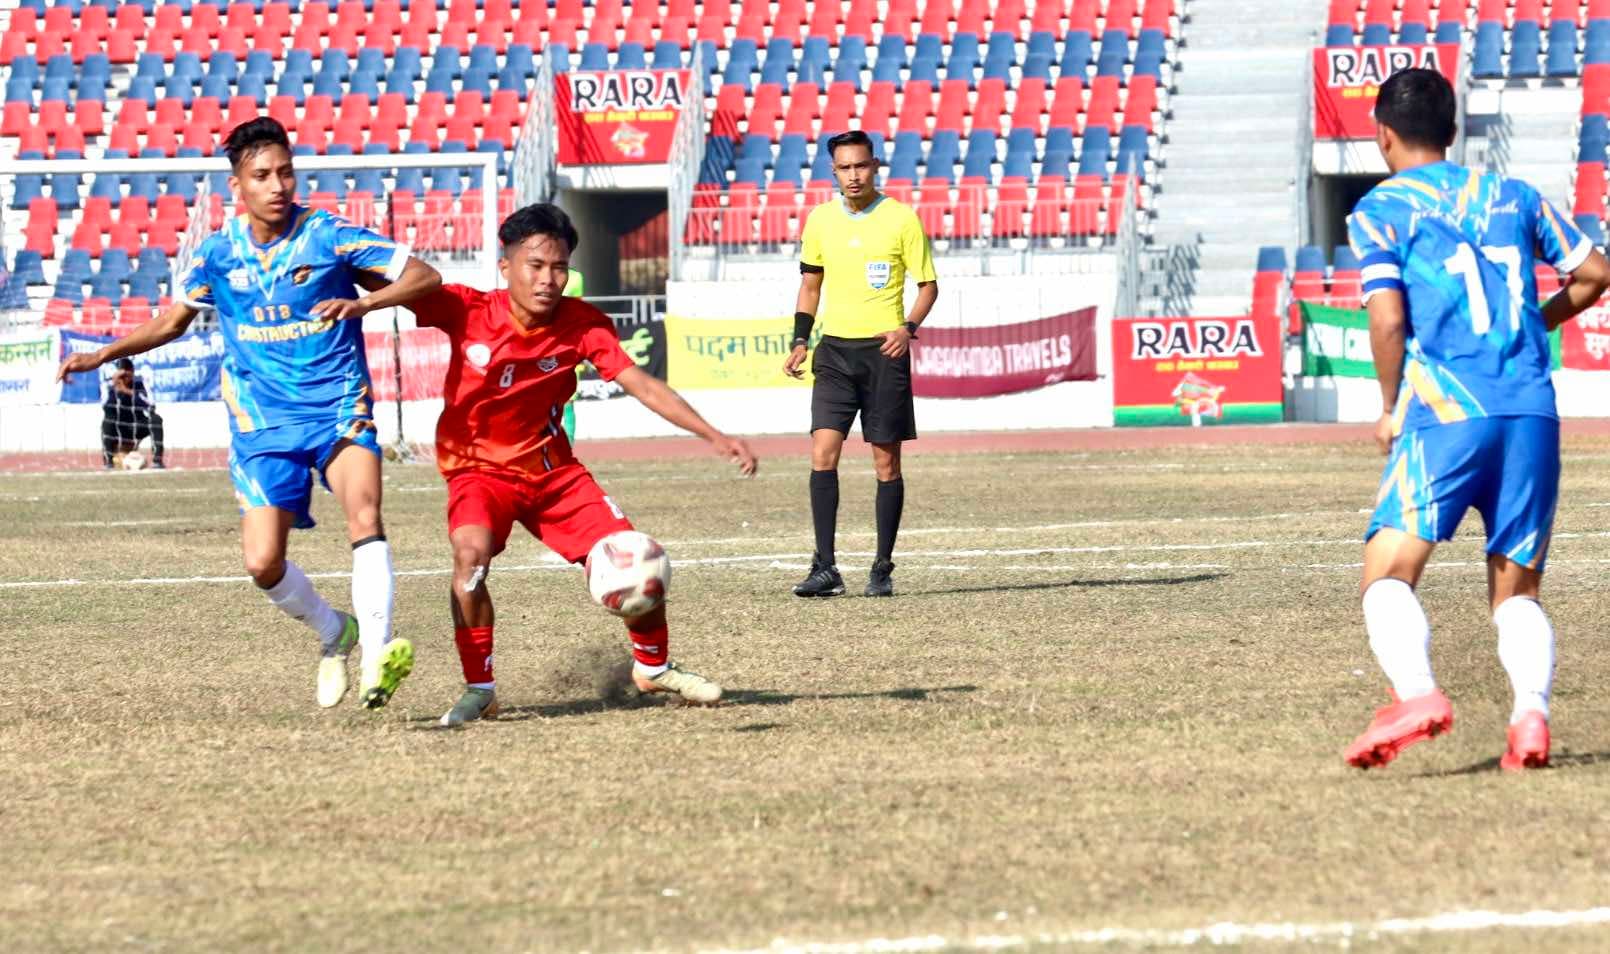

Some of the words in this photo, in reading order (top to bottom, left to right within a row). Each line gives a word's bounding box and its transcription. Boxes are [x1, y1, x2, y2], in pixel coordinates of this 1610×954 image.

[1328, 48, 1441, 87] RARA
[571, 73, 685, 112] RARA
[868, 262, 888, 271] FIFA
[1444, 241, 1524, 335] 17
[1003, 334, 1073, 374] TRAVELS
[1131, 320, 1264, 360] RARA
[499, 363, 517, 388] 8
